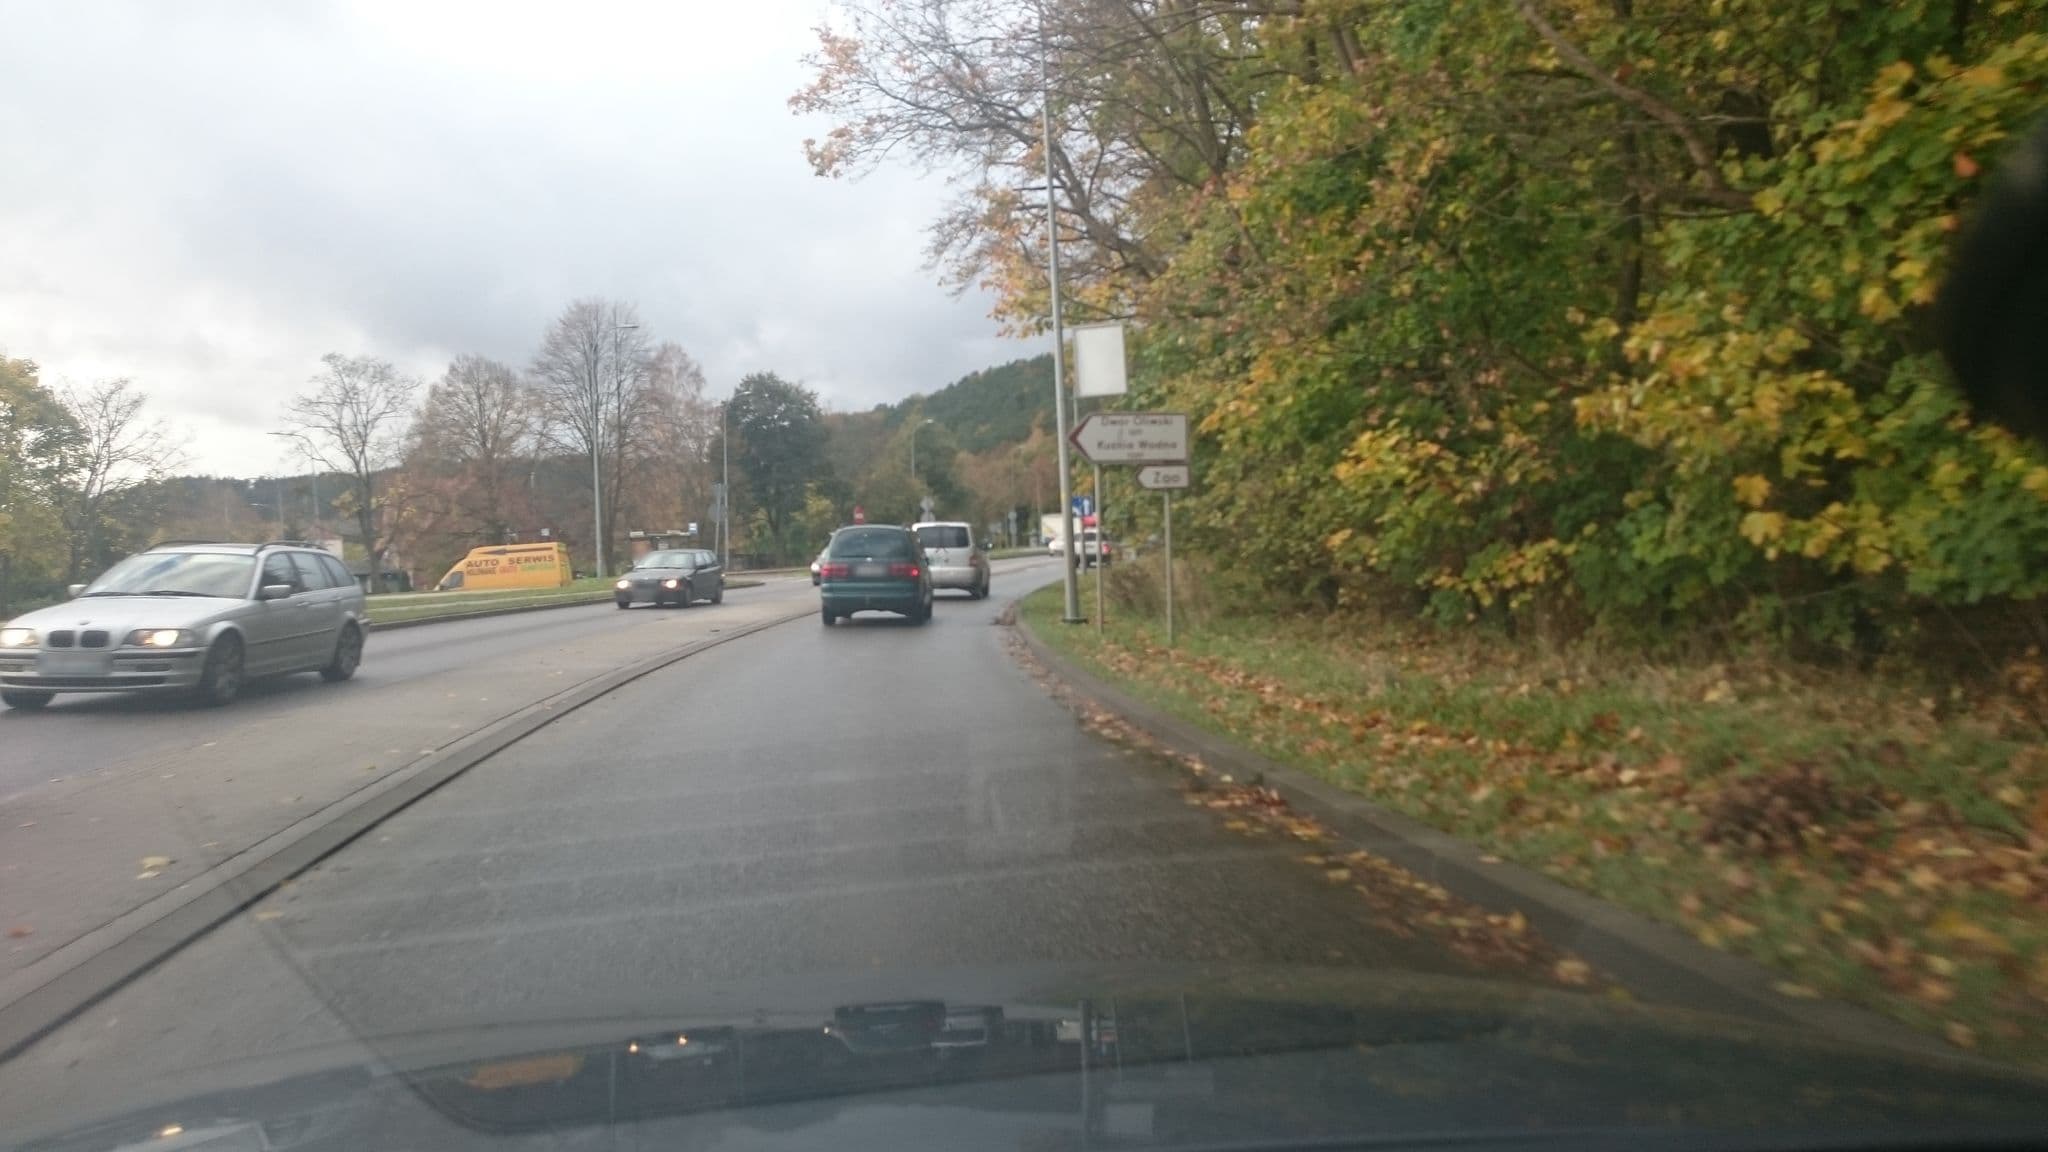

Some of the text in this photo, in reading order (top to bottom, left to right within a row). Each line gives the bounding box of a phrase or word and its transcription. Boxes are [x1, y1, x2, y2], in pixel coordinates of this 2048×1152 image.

[1138, 440, 1177, 449] Wodna
[1152, 471, 1181, 484] Zoo
[466, 554, 555, 568] AUTO SERWIS
